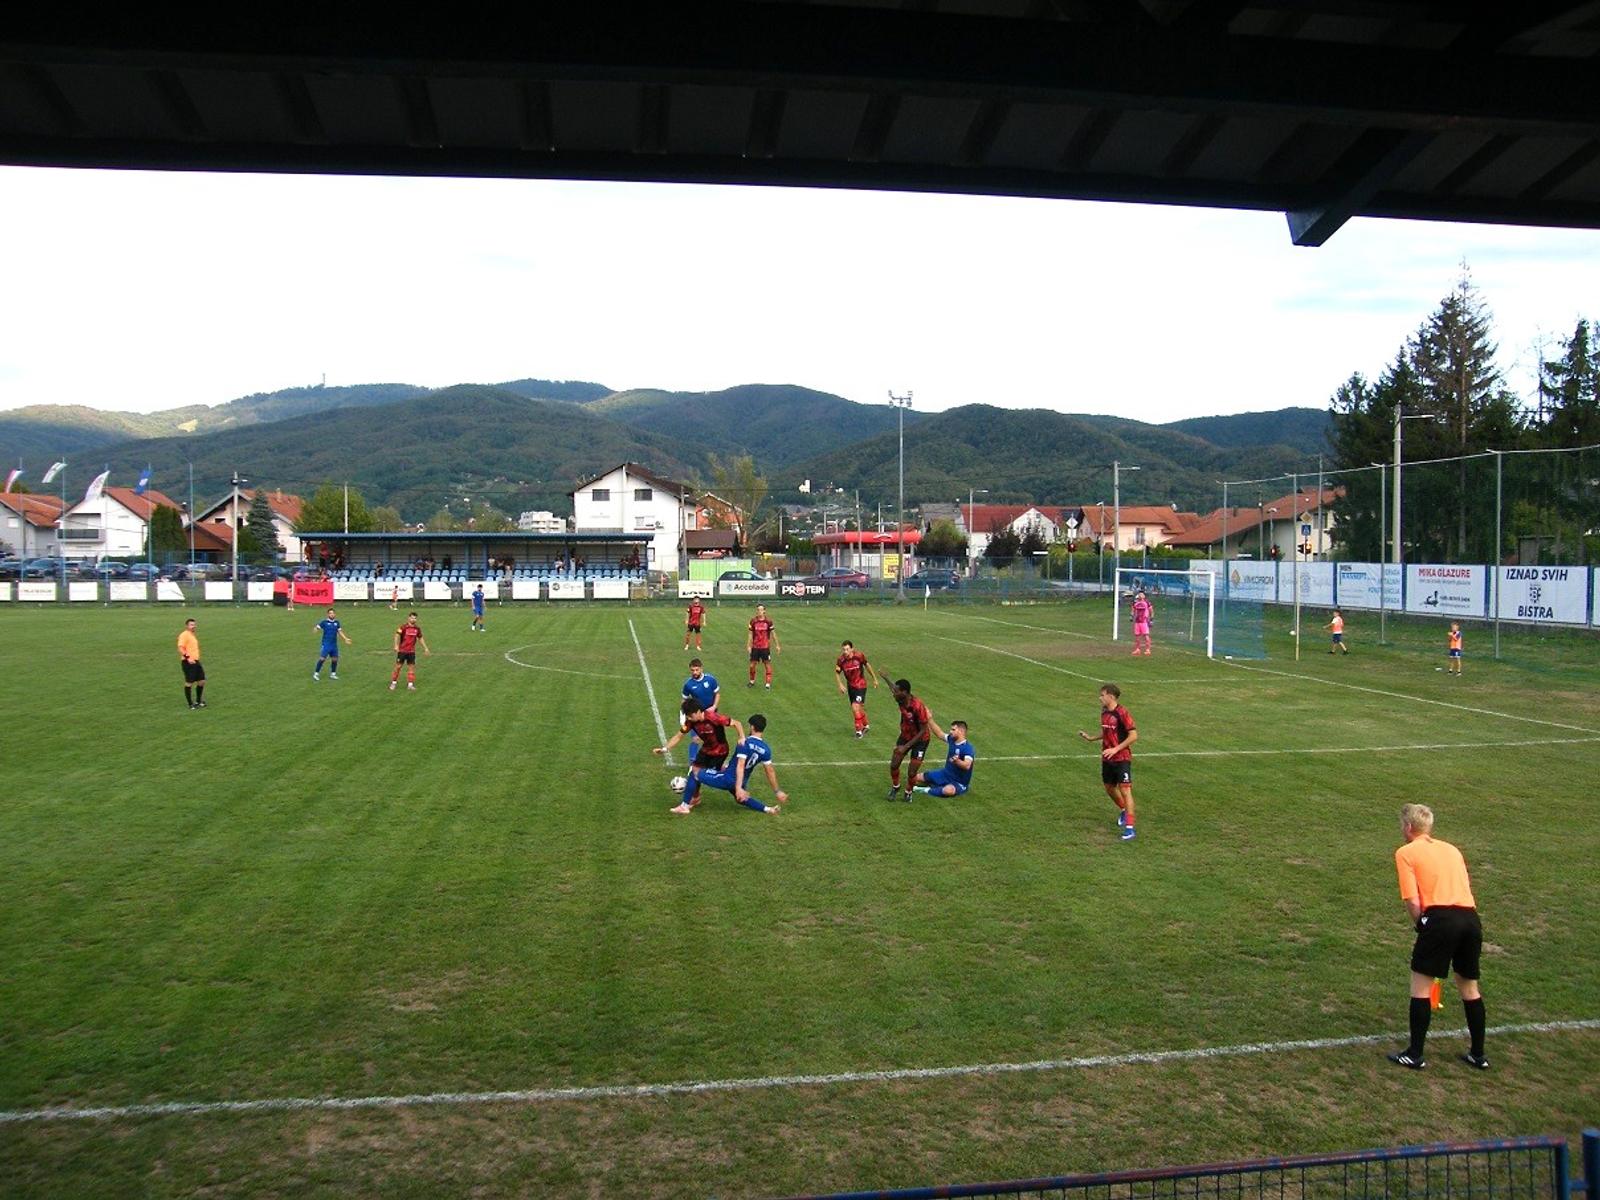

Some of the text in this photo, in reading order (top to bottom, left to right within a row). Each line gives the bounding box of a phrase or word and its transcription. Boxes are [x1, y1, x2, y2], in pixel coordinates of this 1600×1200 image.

[1437, 567, 1471, 578] GLAZURE
[1506, 568, 1568, 581] IZNAD SVIH
[733, 582, 770, 591] Accolade
[1517, 605, 1553, 618] BISTRA
